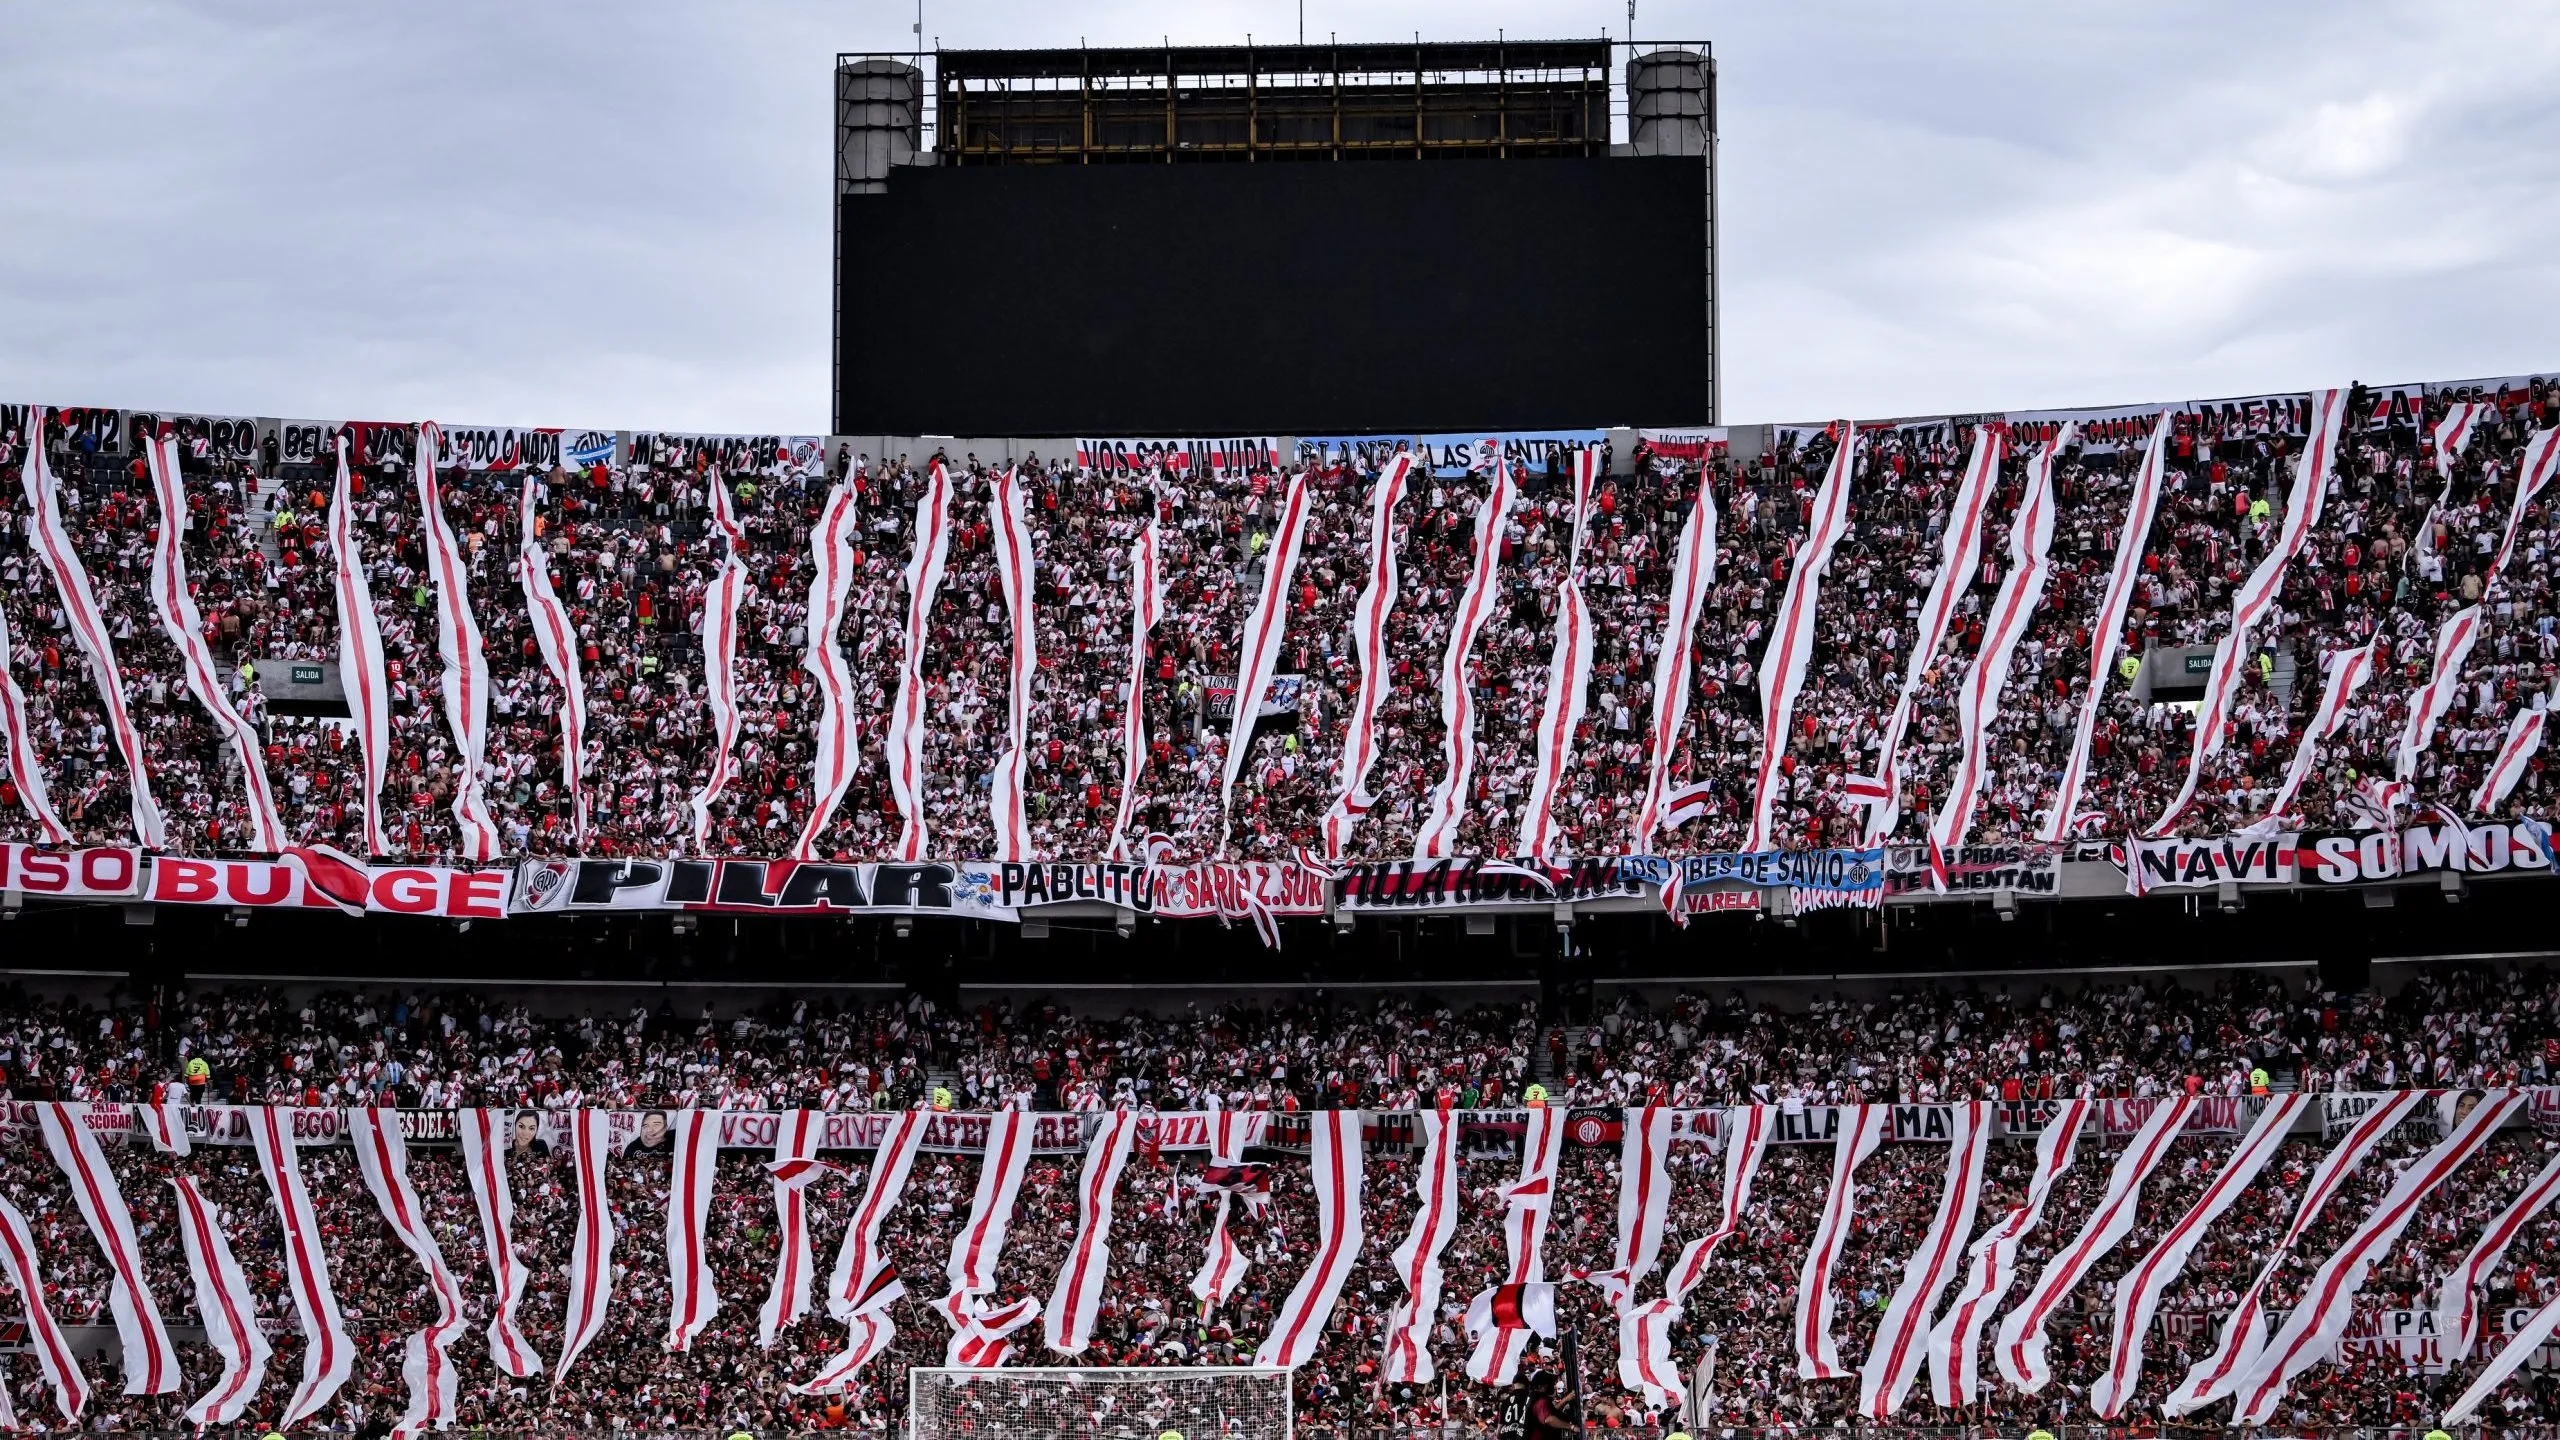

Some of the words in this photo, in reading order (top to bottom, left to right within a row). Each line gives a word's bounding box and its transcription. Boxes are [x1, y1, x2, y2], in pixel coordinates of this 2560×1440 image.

[2012, 419, 2044, 447] SOY
[519, 431, 559, 466] NADA
[1081, 438, 1128, 477] VOS
[1186, 439, 1212, 476] MI
[1218, 437, 1272, 477] VIDA
[1426, 442, 1470, 469] LAS
[295, 670, 319, 680] SALIDA
[390, 666, 401, 676] 10
[2188, 660, 2212, 670] SALIDA
[1914, 849, 1953, 867] LS
[1959, 846, 2018, 866] PIBAS
[2312, 823, 2550, 883] SOMOS
[1619, 857, 1659, 881] LOS
[1667, 856, 1734, 882] IBES
[1741, 855, 1771, 881] DE
[1776, 851, 1843, 889] SAVIO
[1884, 871, 1920, 892] TE
[1929, 867, 2053, 893] LIENTAN
[153, 857, 505, 919] BUGE
[568, 860, 953, 908] PILAR
[1000, 863, 1154, 913] PABLITO
[1686, 891, 1761, 912] VARELA
[81, 1113, 132, 1131] ESCOBAR
[417, 1111, 446, 1139] DEL
[2342, 1341, 2400, 1364] SAN
